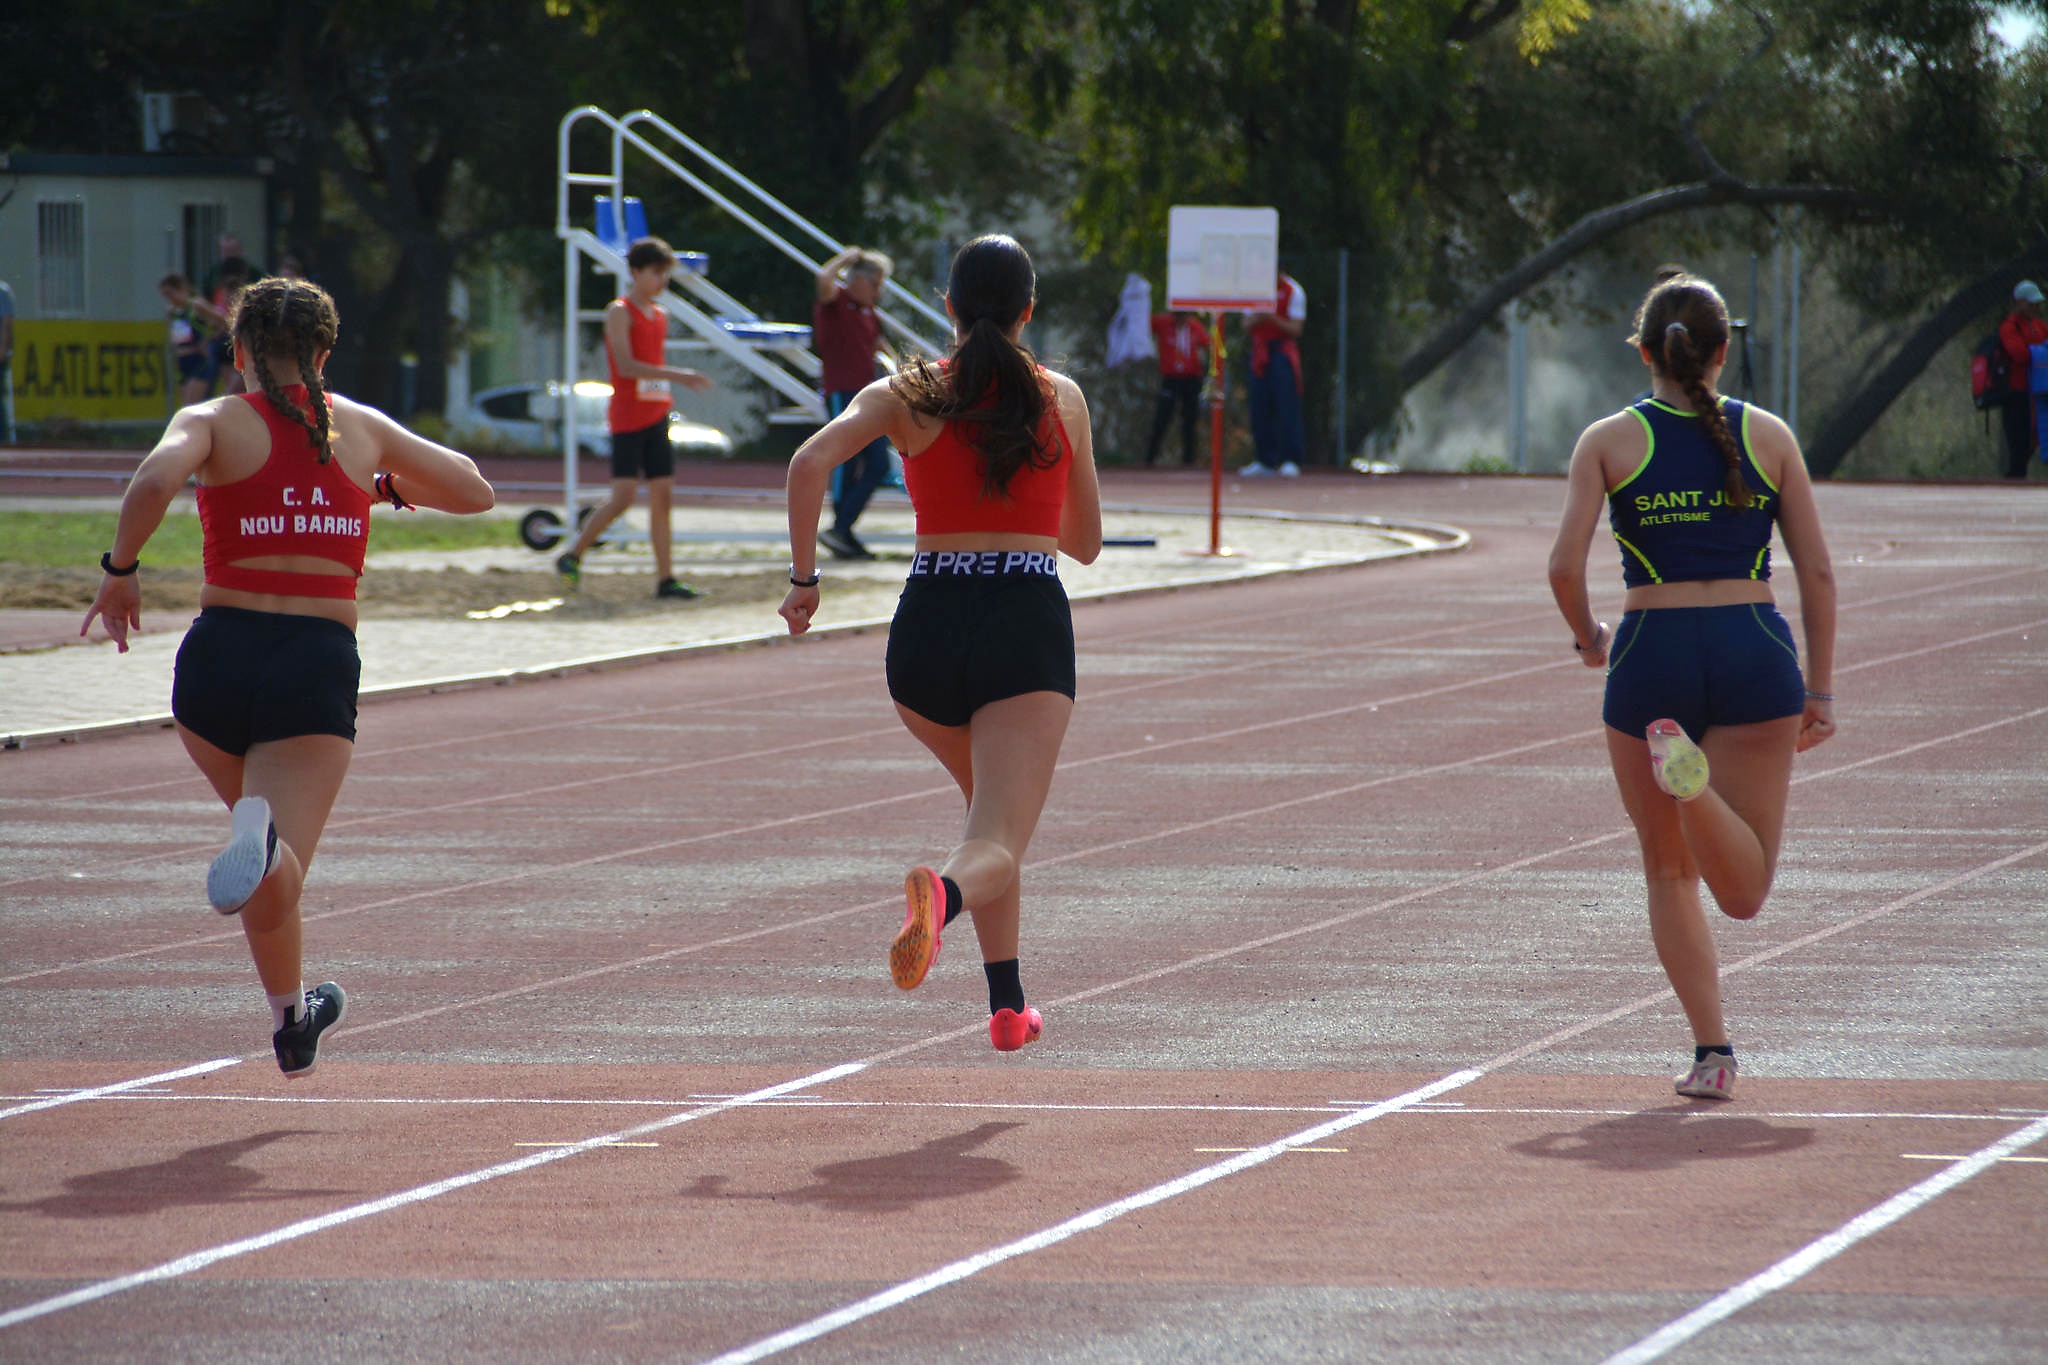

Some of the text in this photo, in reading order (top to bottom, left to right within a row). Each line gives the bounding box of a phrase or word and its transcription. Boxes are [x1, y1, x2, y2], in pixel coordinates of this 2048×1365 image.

[282, 486, 330, 506] C. A.
[1635, 491, 1703, 511] SANT
[240, 515, 361, 536] NOU BARRIS
[1639, 512, 1711, 527] ATLETISME
[934, 552, 999, 575] PRE
